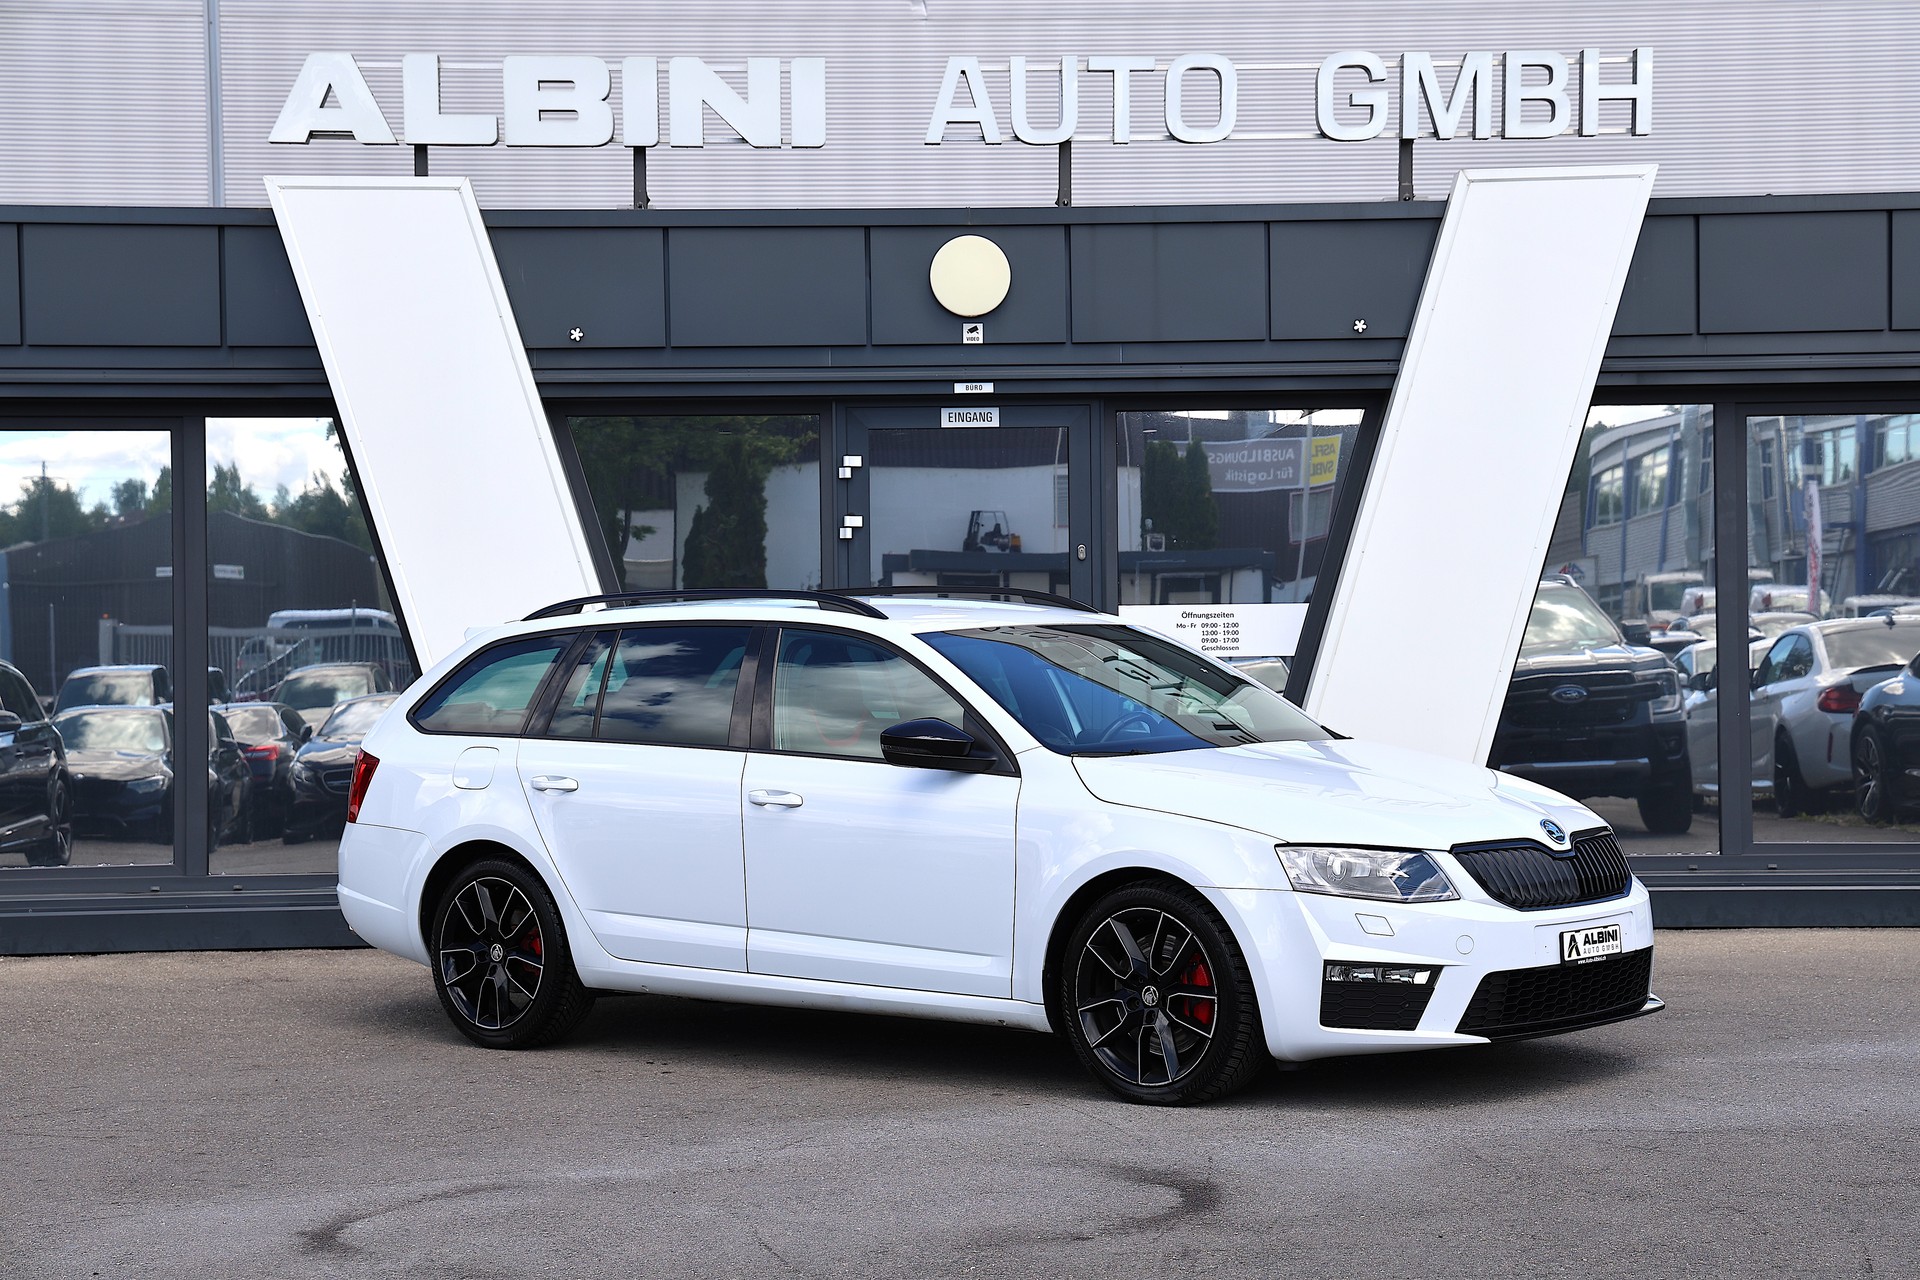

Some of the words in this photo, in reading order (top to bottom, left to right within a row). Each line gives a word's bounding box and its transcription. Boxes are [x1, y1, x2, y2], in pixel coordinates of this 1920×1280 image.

[268, 53, 826, 148] ALBINI
[924, 53, 1238, 146] AUTO
[1315, 47, 1654, 141] GMBH
[948, 411, 993, 423] EINGANG
[1181, 611, 1235, 620] Öffnungszeiten
[1583, 929, 1618, 946] ALBINI
[1583, 946, 1600, 955] AUTO
